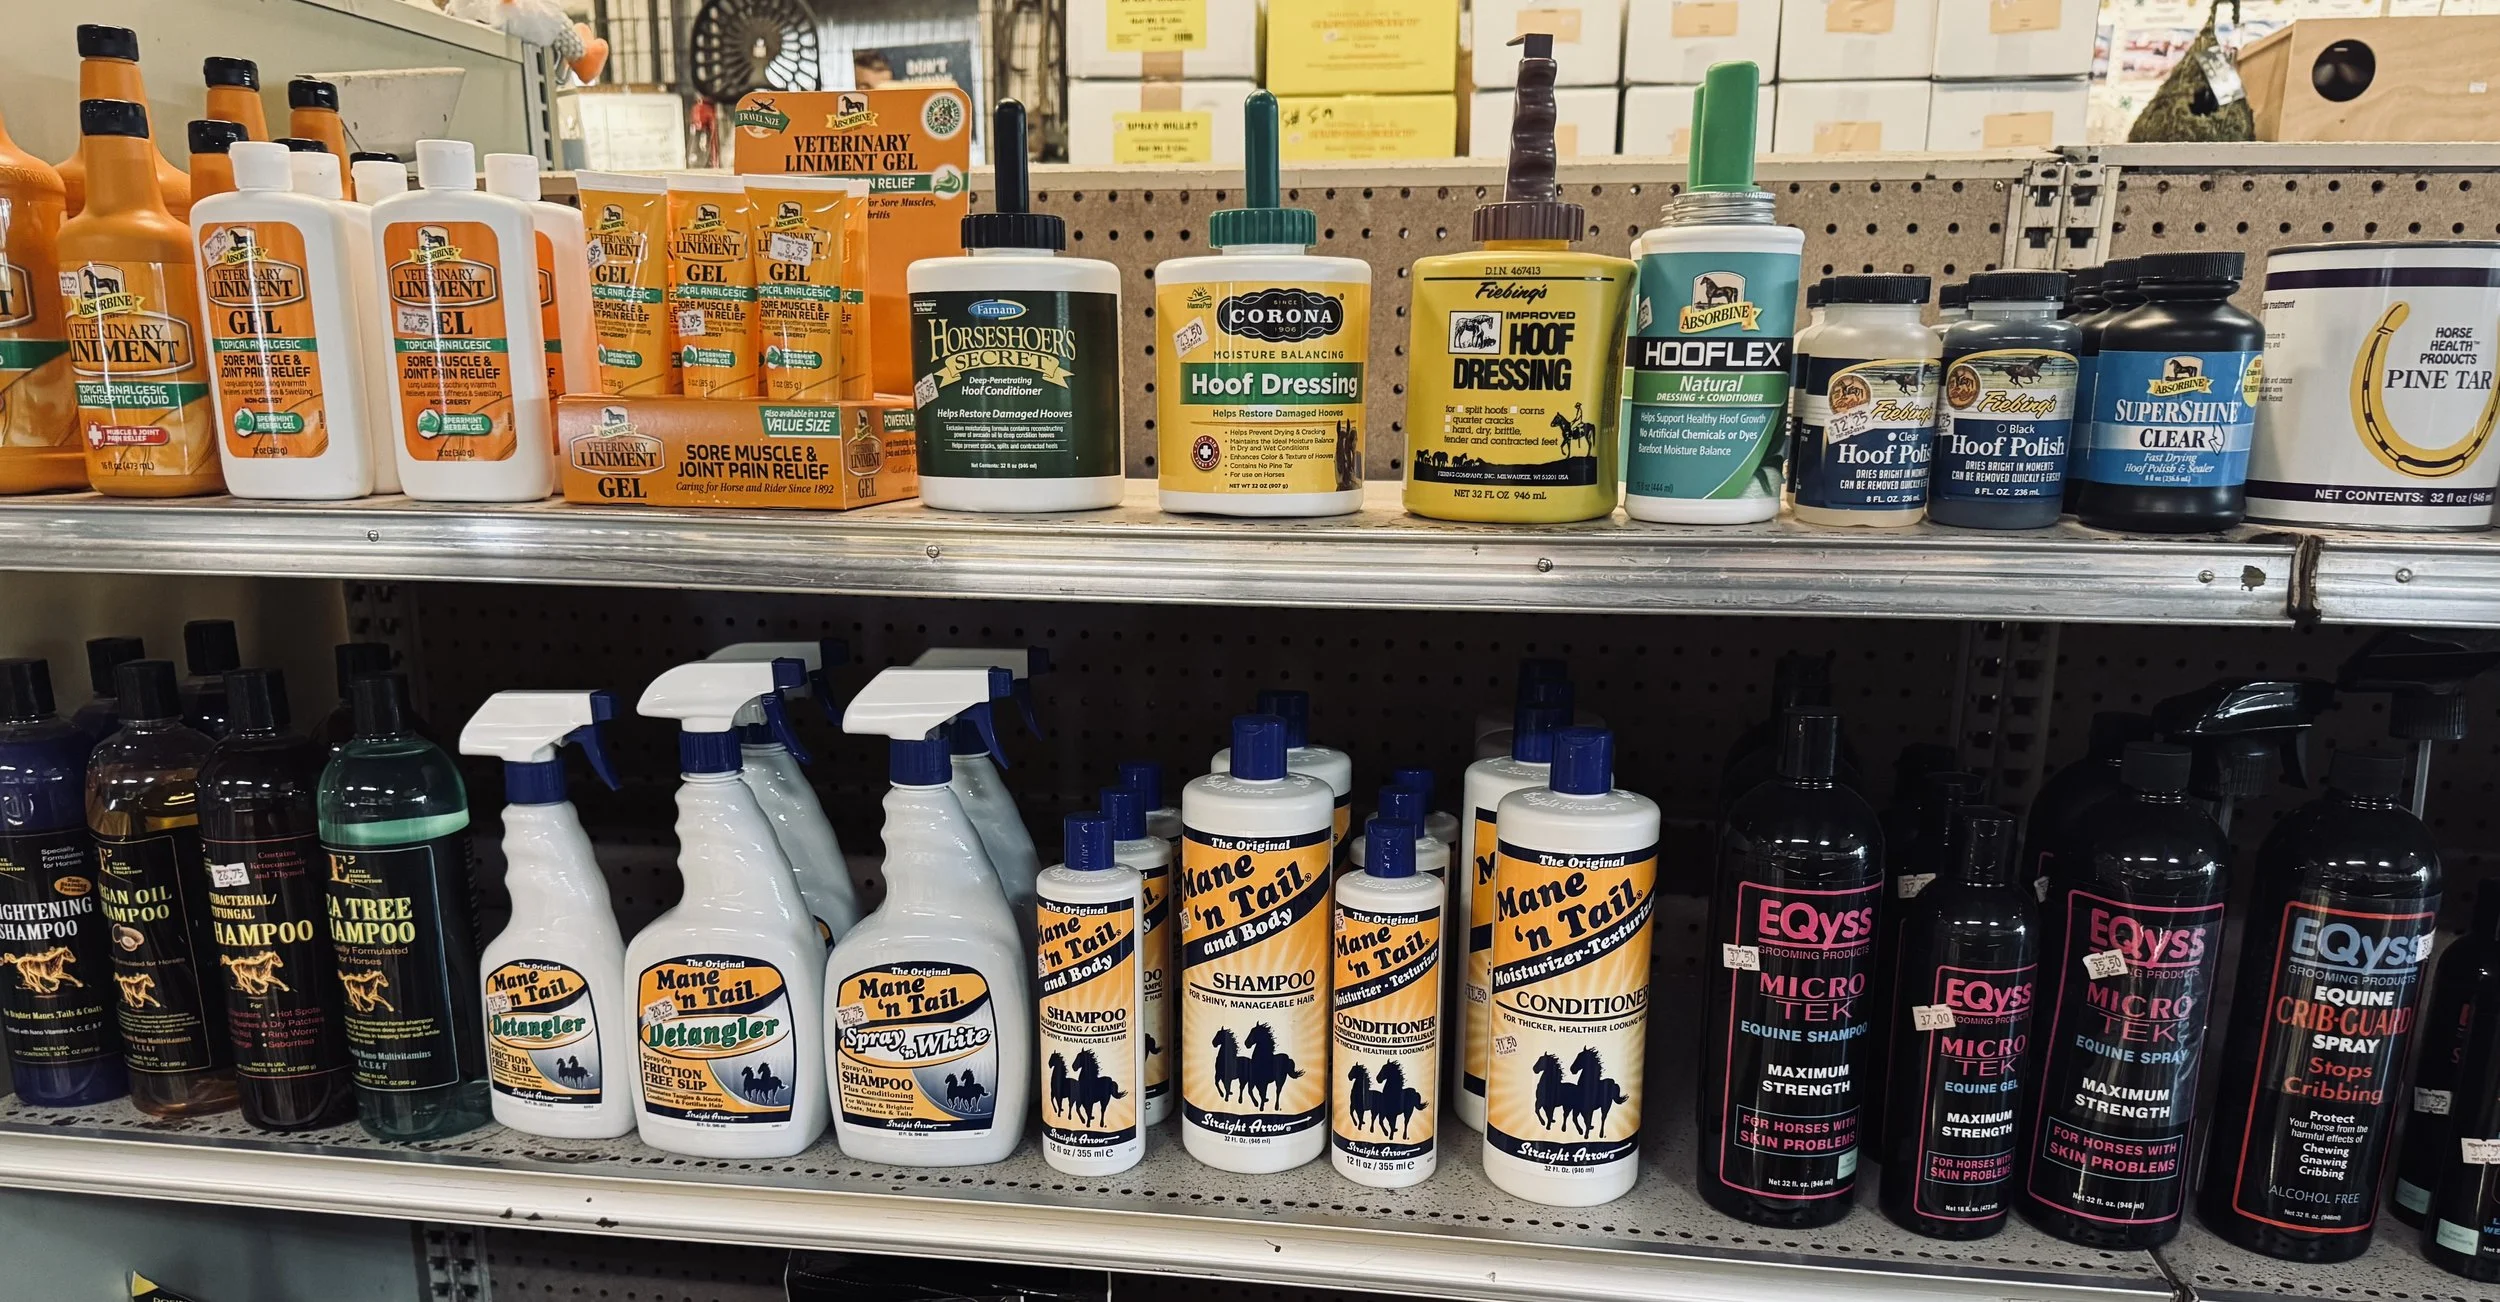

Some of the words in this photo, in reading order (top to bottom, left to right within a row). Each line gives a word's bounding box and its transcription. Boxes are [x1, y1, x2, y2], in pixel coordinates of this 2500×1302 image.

[739, 113, 763, 123] TRAVEL
[764, 118, 779, 126] SIZE
[795, 134, 911, 153] VETERINARY
[785, 154, 877, 171] LINIMENT
[883, 154, 917, 170] GEL
[878, 178, 915, 188] RELIEF
[676, 242, 740, 256] LINIMENT
[687, 264, 727, 282] GEL
[1511, 267, 1540, 275] 467413
[1475, 282, 1547, 304] Fiebing's
[977, 306, 1016, 314] Farnam
[1230, 309, 1333, 323] CORONA
[1506, 312, 1575, 320] IMPROVED
[1681, 305, 1749, 330] ABSORBINE
[1509, 323, 1575, 355] HOOF
[2435, 328, 2472, 338] HORSE
[928, 319, 1076, 363] HORSESHOER'S
[2430, 341, 2472, 351] HEALTH
[955, 351, 1048, 370] SECRET
[1214, 351, 1275, 359] MOISTURE
[1281, 351, 1343, 359] BALANCING
[1645, 342, 1780, 366] HOOFLEX
[2420, 353, 2476, 364] PRODUCTS
[970, 377, 1032, 386] Deep-Penetrating
[1453, 358, 1571, 391] DRESSING
[2386, 371, 2446, 388] PINE
[2455, 371, 2492, 389] TAR
[79, 386, 106, 395] TOPICAL
[108, 386, 167, 395] ANALGESIC
[962, 386, 984, 396] Hoof
[986, 386, 1042, 396] Conditioner
[1192, 374, 1254, 394] Hoof
[1262, 373, 1358, 398] Dressing
[1680, 375, 1743, 392] Natural
[2155, 378, 2204, 395] ABSORBINE
[134, 396, 169, 405] LIQUID
[1656, 393, 1695, 401] DRESSING
[1707, 394, 1762, 402] CONDITIONER
[1978, 391, 2056, 419] Fiebing's
[937, 409, 958, 418] Helps
[959, 410, 991, 418] Restore
[993, 410, 1038, 420] Damaged
[1040, 409, 1072, 418] Hooves
[1213, 410, 1237, 418] Helps
[1275, 410, 1316, 418] Damaged
[1319, 409, 1343, 417] Hooves
[1465, 405, 1482, 415] split
[2115, 399, 2238, 423] SUPERSHINE
[766, 419, 803, 431] VALUE
[806, 420, 830, 432] SIZE
[1453, 416, 1483, 425] quarter
[1656, 413, 1684, 425] Support
[1687, 414, 1717, 425] Healthy
[1719, 415, 1739, 424] Hoof
[1740, 415, 1765, 424] Growth
[1835, 413, 1868, 433] 12.25
[1302, 428, 1325, 436] Cracking
[1649, 429, 1679, 438] Artificial
[1682, 429, 1725, 439] Chemicals
[1739, 430, 1757, 440] Dyes
[2009, 424, 2035, 434] Black
[1490, 437, 1539, 445] contracted
[1541, 437, 1558, 445] feet
[1899, 433, 1919, 442] Clear
[2140, 427, 2205, 448] CLEAR
[687, 445, 733, 462] SORE
[736, 446, 803, 462] MUSCLE
[1663, 444, 1697, 455] Moisture
[1700, 446, 1731, 456] Balance
[1951, 435, 2006, 455] Hoof
[2009, 437, 2064, 457] Polish
[581, 452, 656, 467] LINIMENT
[2144, 453, 2164, 462] Fast
[2166, 454, 2197, 464] Drying
[678, 463, 725, 477] JOINT
[730, 463, 770, 479] PAIN
[774, 464, 829, 479] RELIEF
[2125, 463, 2145, 472] Hoof
[2147, 463, 2175, 473] Polish
[2189, 464, 2214, 473] Sealer
[598, 479, 647, 498] GEL
[676, 482, 701, 494] Caring
[703, 482, 718, 494] for
[720, 482, 743, 492] Horse
[746, 482, 762, 492] and
[764, 483, 786, 493] Rider
[789, 484, 811, 493] Since
[814, 485, 834, 494] 1892
[1454, 490, 1471, 498] NET
[1472, 490, 1483, 498] 32
[2315, 488, 2341, 500] NET
[2345, 490, 2423, 502] CONTENTS:
[218, 870, 244, 882] 26.75
[1183, 854, 1255, 901] Mane
[135, 886, 172, 904] OIL
[346, 898, 412, 920] TREE
[1758, 899, 1872, 949] EQyss
[1336, 926, 1391, 958] Mane
[352, 948, 408, 956] Formulated
[2093, 958, 2121, 971] 35.50
[657, 968, 720, 990] Mane
[1213, 970, 1315, 991] SHAMPOO
[1760, 973, 1864, 999] MICRO
[858, 978, 925, 998] Mane
[2315, 986, 2394, 1006] EQUINE
[1776, 1000, 1853, 1021] TEK
[2276, 996, 2411, 1036] CRIB-GUARD
[493, 1015, 586, 1039] Detangler
[1337, 1012, 1434, 1034] CONDITIONER
[1921, 1013, 1949, 1026] 37.00
[650, 1016, 779, 1048] Detangler
[1559, 1025, 1607, 1033] HEALTHIER
[1741, 1021, 1802, 1041] EQUINE
[1807, 1023, 1867, 1042] SHAMPOO
[845, 1028, 904, 1053] Spray
[916, 1028, 990, 1058] White
[2313, 1034, 2380, 1054] SPRAY
[2140, 1048, 2187, 1063] SPRAY
[643, 1061, 702, 1079] FRICTION
[1768, 1064, 1849, 1079] MAXIMUM
[2308, 1057, 2372, 1080] Stops
[645, 1074, 674, 1087] FREE
[678, 1079, 707, 1091] SLIP
[842, 1072, 913, 1090] SHAMPOO
[1944, 1081, 1996, 1093] EQUINE
[2000, 1080, 2018, 1092] GEL
[844, 1085, 858, 1093] Plus
[861, 1088, 914, 1100] Conditioning
[2284, 1076, 2383, 1104] Cribbing
[2310, 1111, 2354, 1123] Protect
[1942, 1125, 2012, 1138] STRENGTH
[2083, 1137, 2143, 1155] HORSES
[2303, 1143, 2349, 1157] Chewing
[2091, 1156, 2175, 1172] PROBLEMS
[2300, 1155, 2348, 1168] Gnawing
[2299, 1166, 2345, 1180] Cribbing
